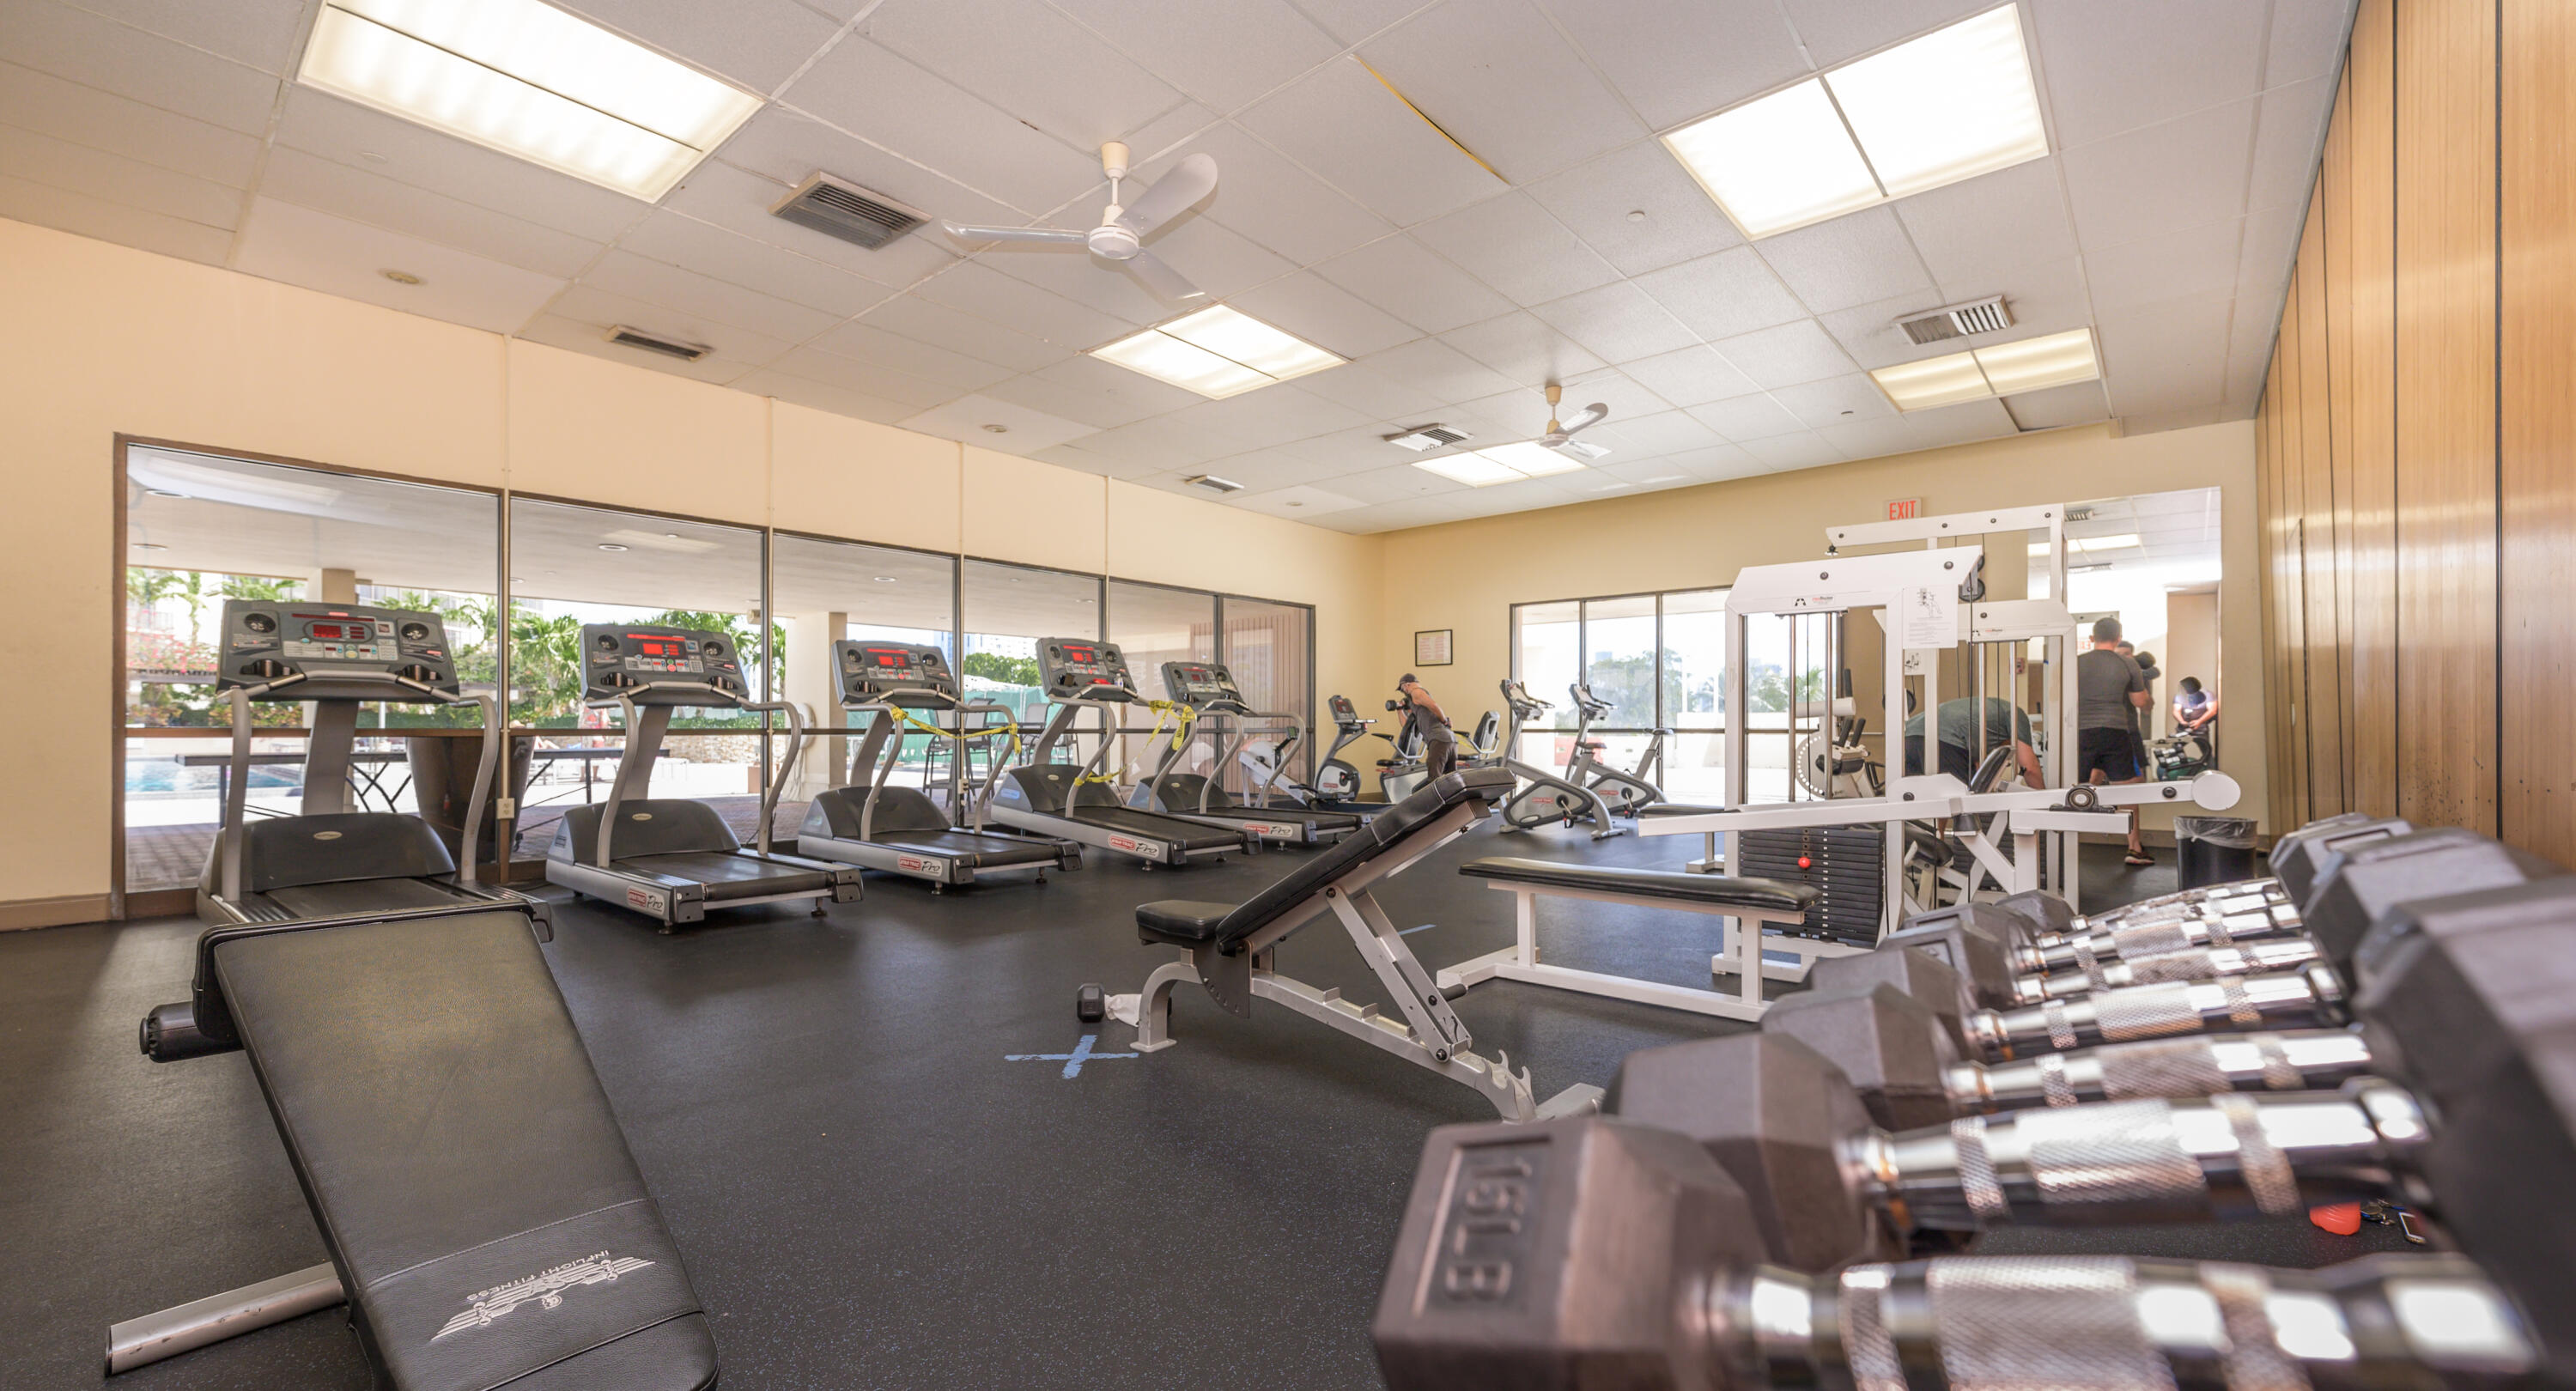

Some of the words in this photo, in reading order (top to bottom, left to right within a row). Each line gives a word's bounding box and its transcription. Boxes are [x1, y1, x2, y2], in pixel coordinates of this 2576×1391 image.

[1889, 501, 1917, 520] EXIT
[1136, 842, 1157, 853] Pro
[921, 860, 941, 872] Pro
[647, 895, 663, 908] Pro
[540, 1249, 609, 1278] INFLIGHT
[466, 1274, 537, 1301] FITNESS
